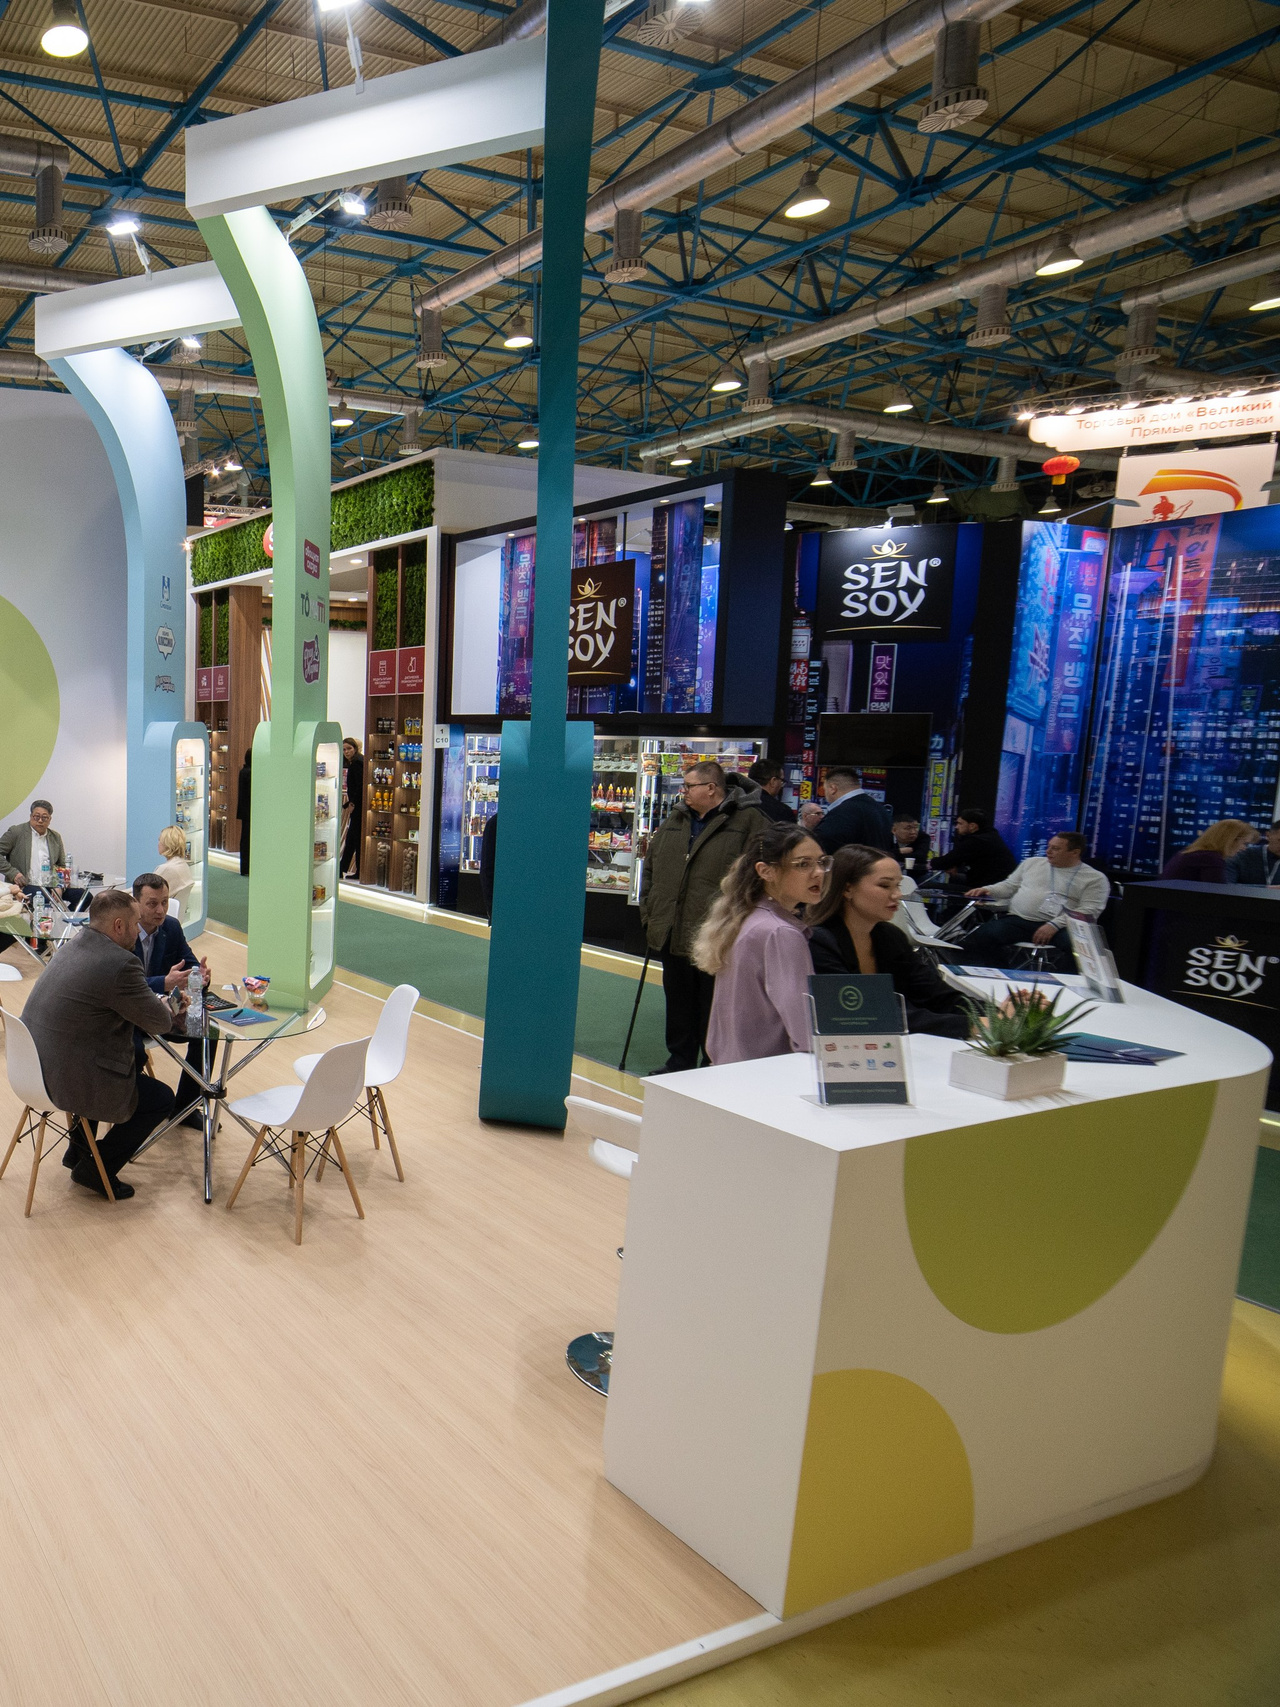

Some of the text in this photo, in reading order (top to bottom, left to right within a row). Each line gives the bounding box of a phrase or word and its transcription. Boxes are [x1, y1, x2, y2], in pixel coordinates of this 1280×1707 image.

[1131, 415, 1274, 438] Прямые поставки
[840, 588, 926, 623] SOY
[1183, 967, 1263, 997] SOY
